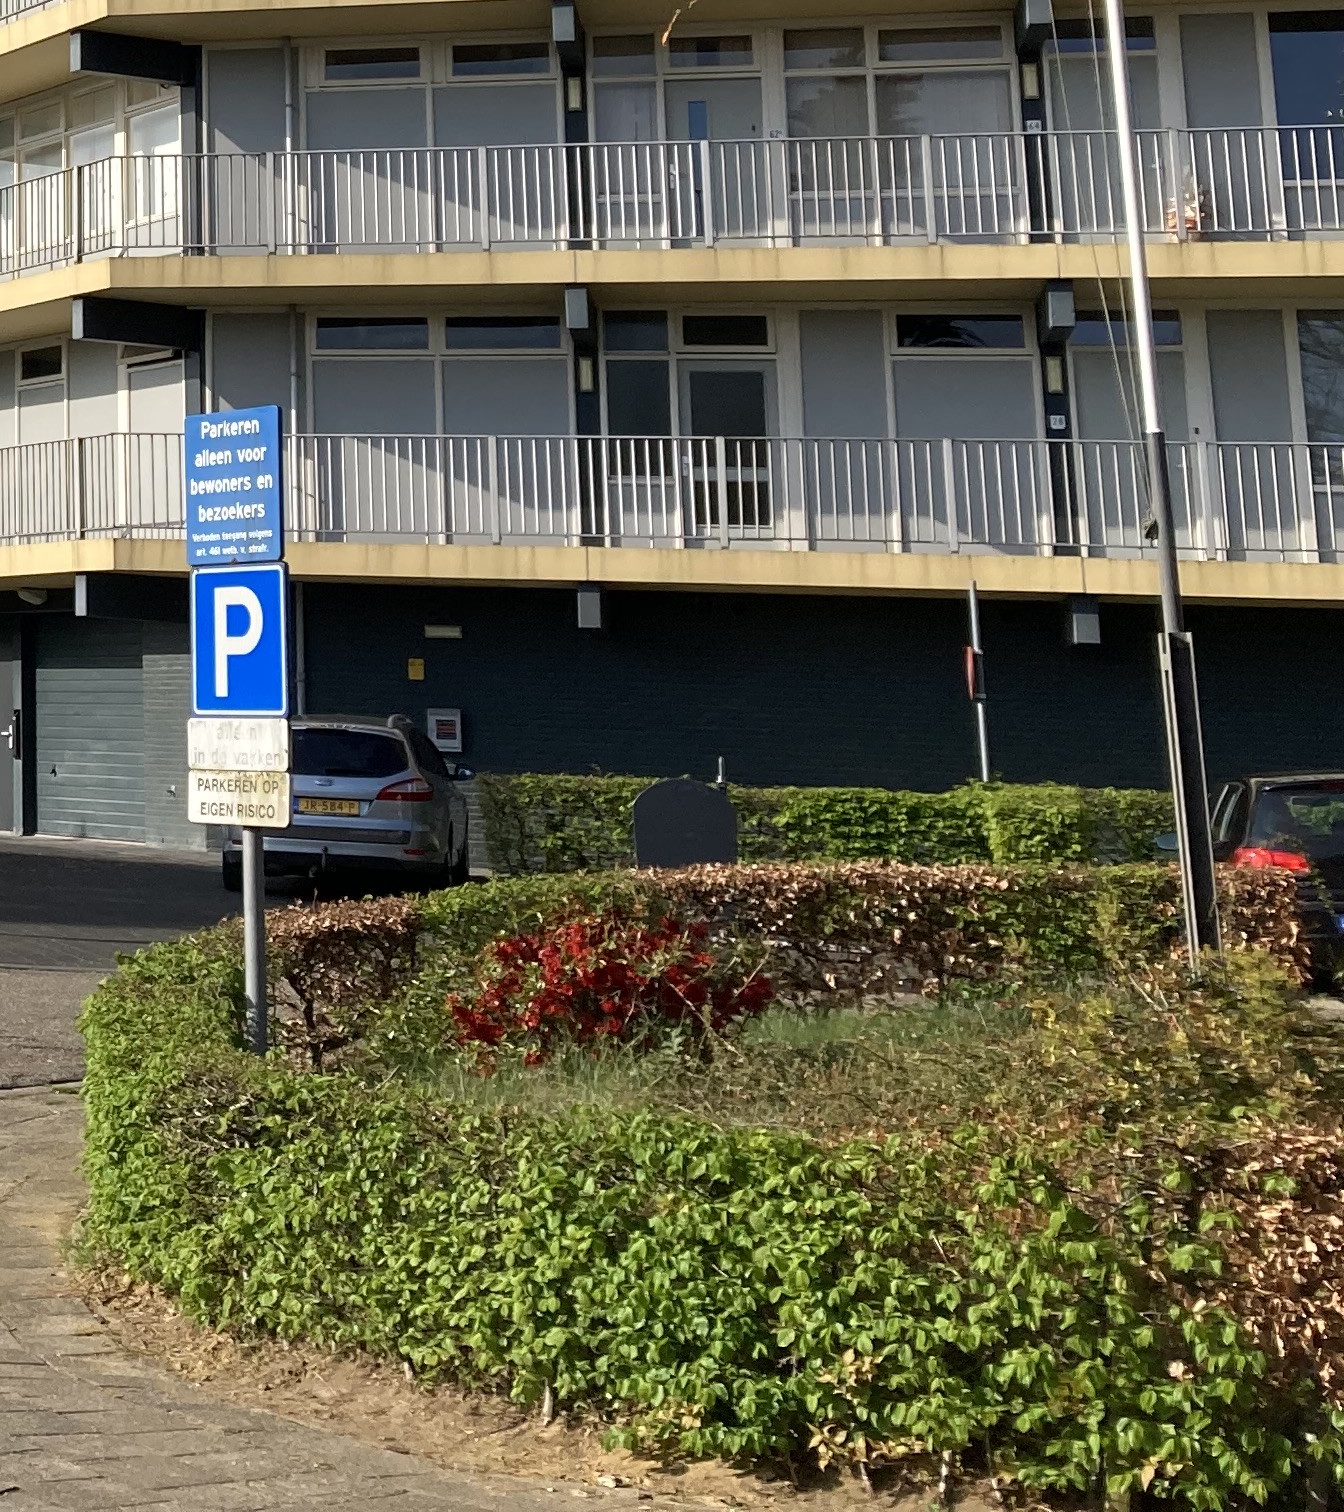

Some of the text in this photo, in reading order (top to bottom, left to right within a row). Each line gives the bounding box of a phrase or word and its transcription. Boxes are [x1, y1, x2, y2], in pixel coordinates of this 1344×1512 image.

[201, 419, 260, 440] Parkeren
[194, 446, 267, 468] alleen voor
[190, 473, 273, 496] bewoners en
[198, 502, 265, 522] bezoekers
[214, 586, 264, 698] P
[197, 777, 280, 794] PARKEREN OP
[200, 801, 276, 819] EIGEN RISICO
